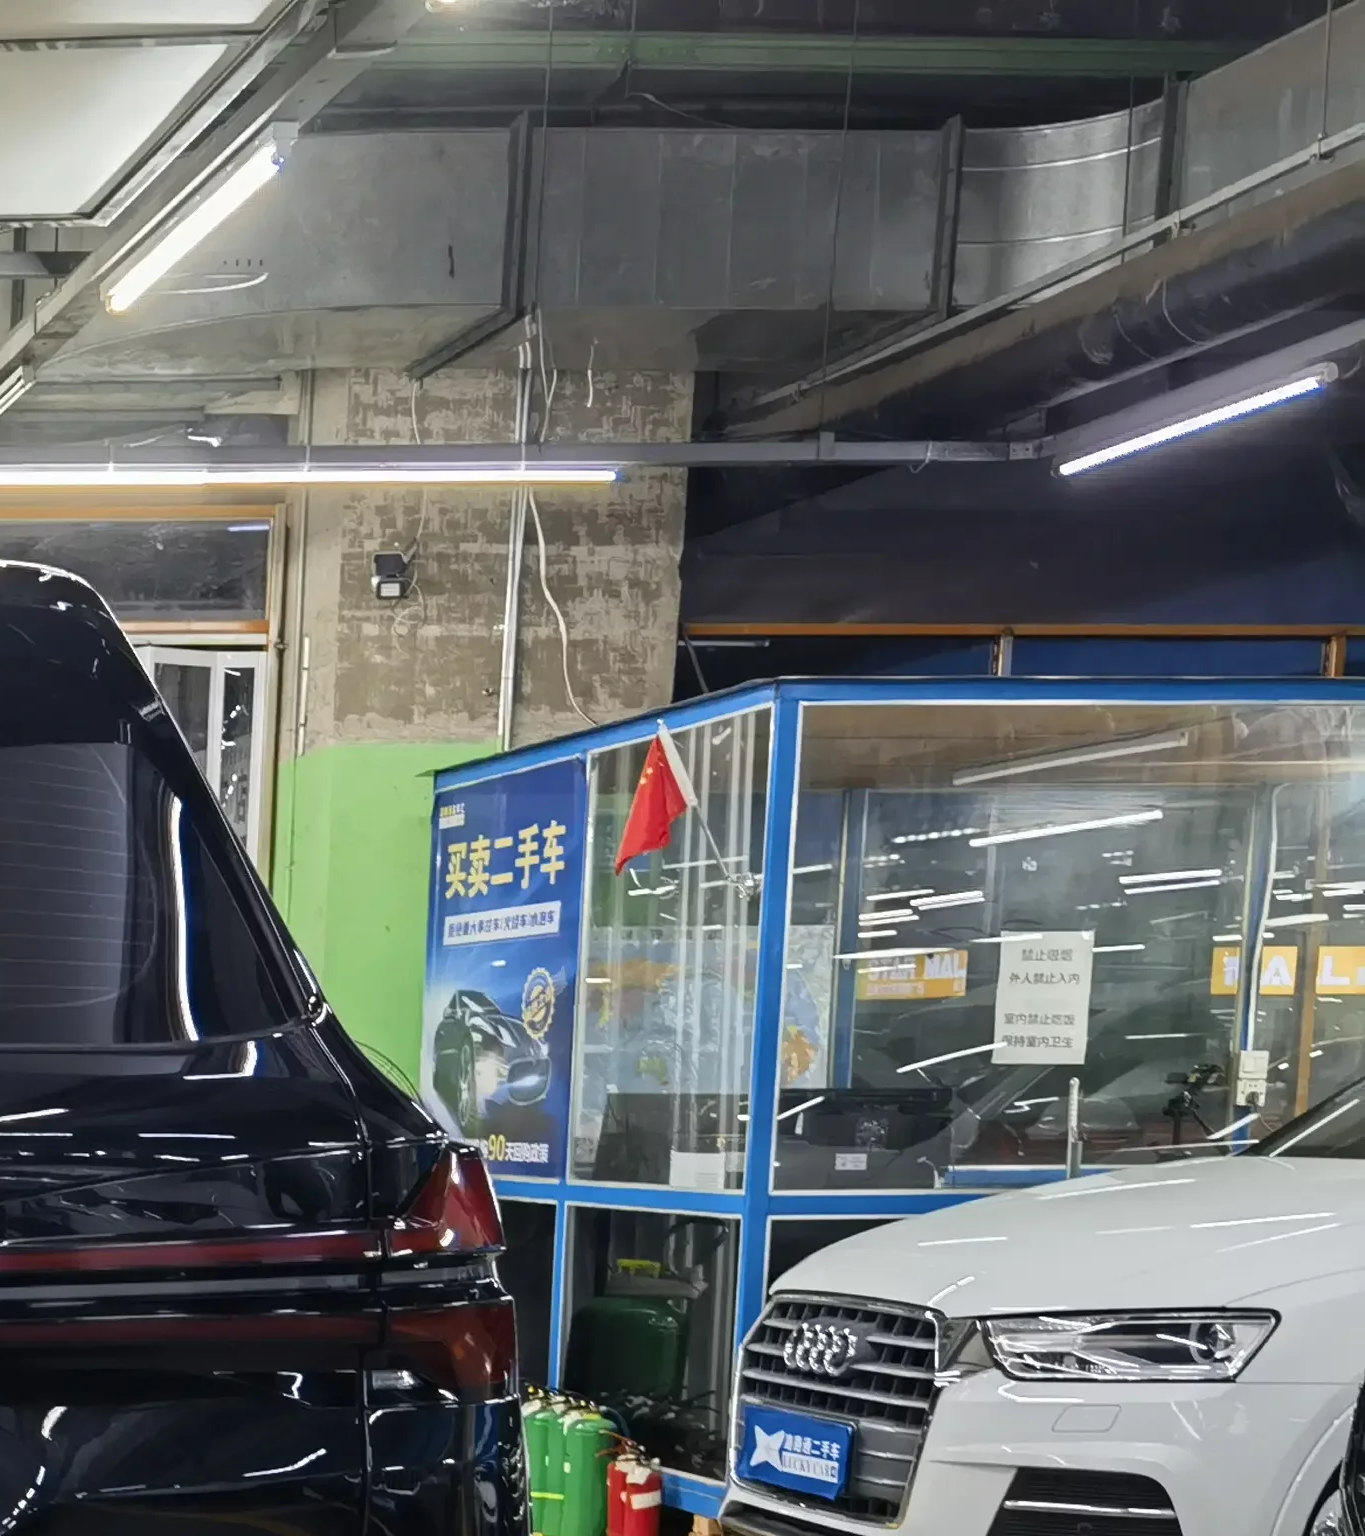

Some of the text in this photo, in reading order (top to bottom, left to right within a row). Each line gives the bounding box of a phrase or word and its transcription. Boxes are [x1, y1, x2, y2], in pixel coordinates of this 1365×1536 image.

[445, 820, 567, 900] 买卖二手车
